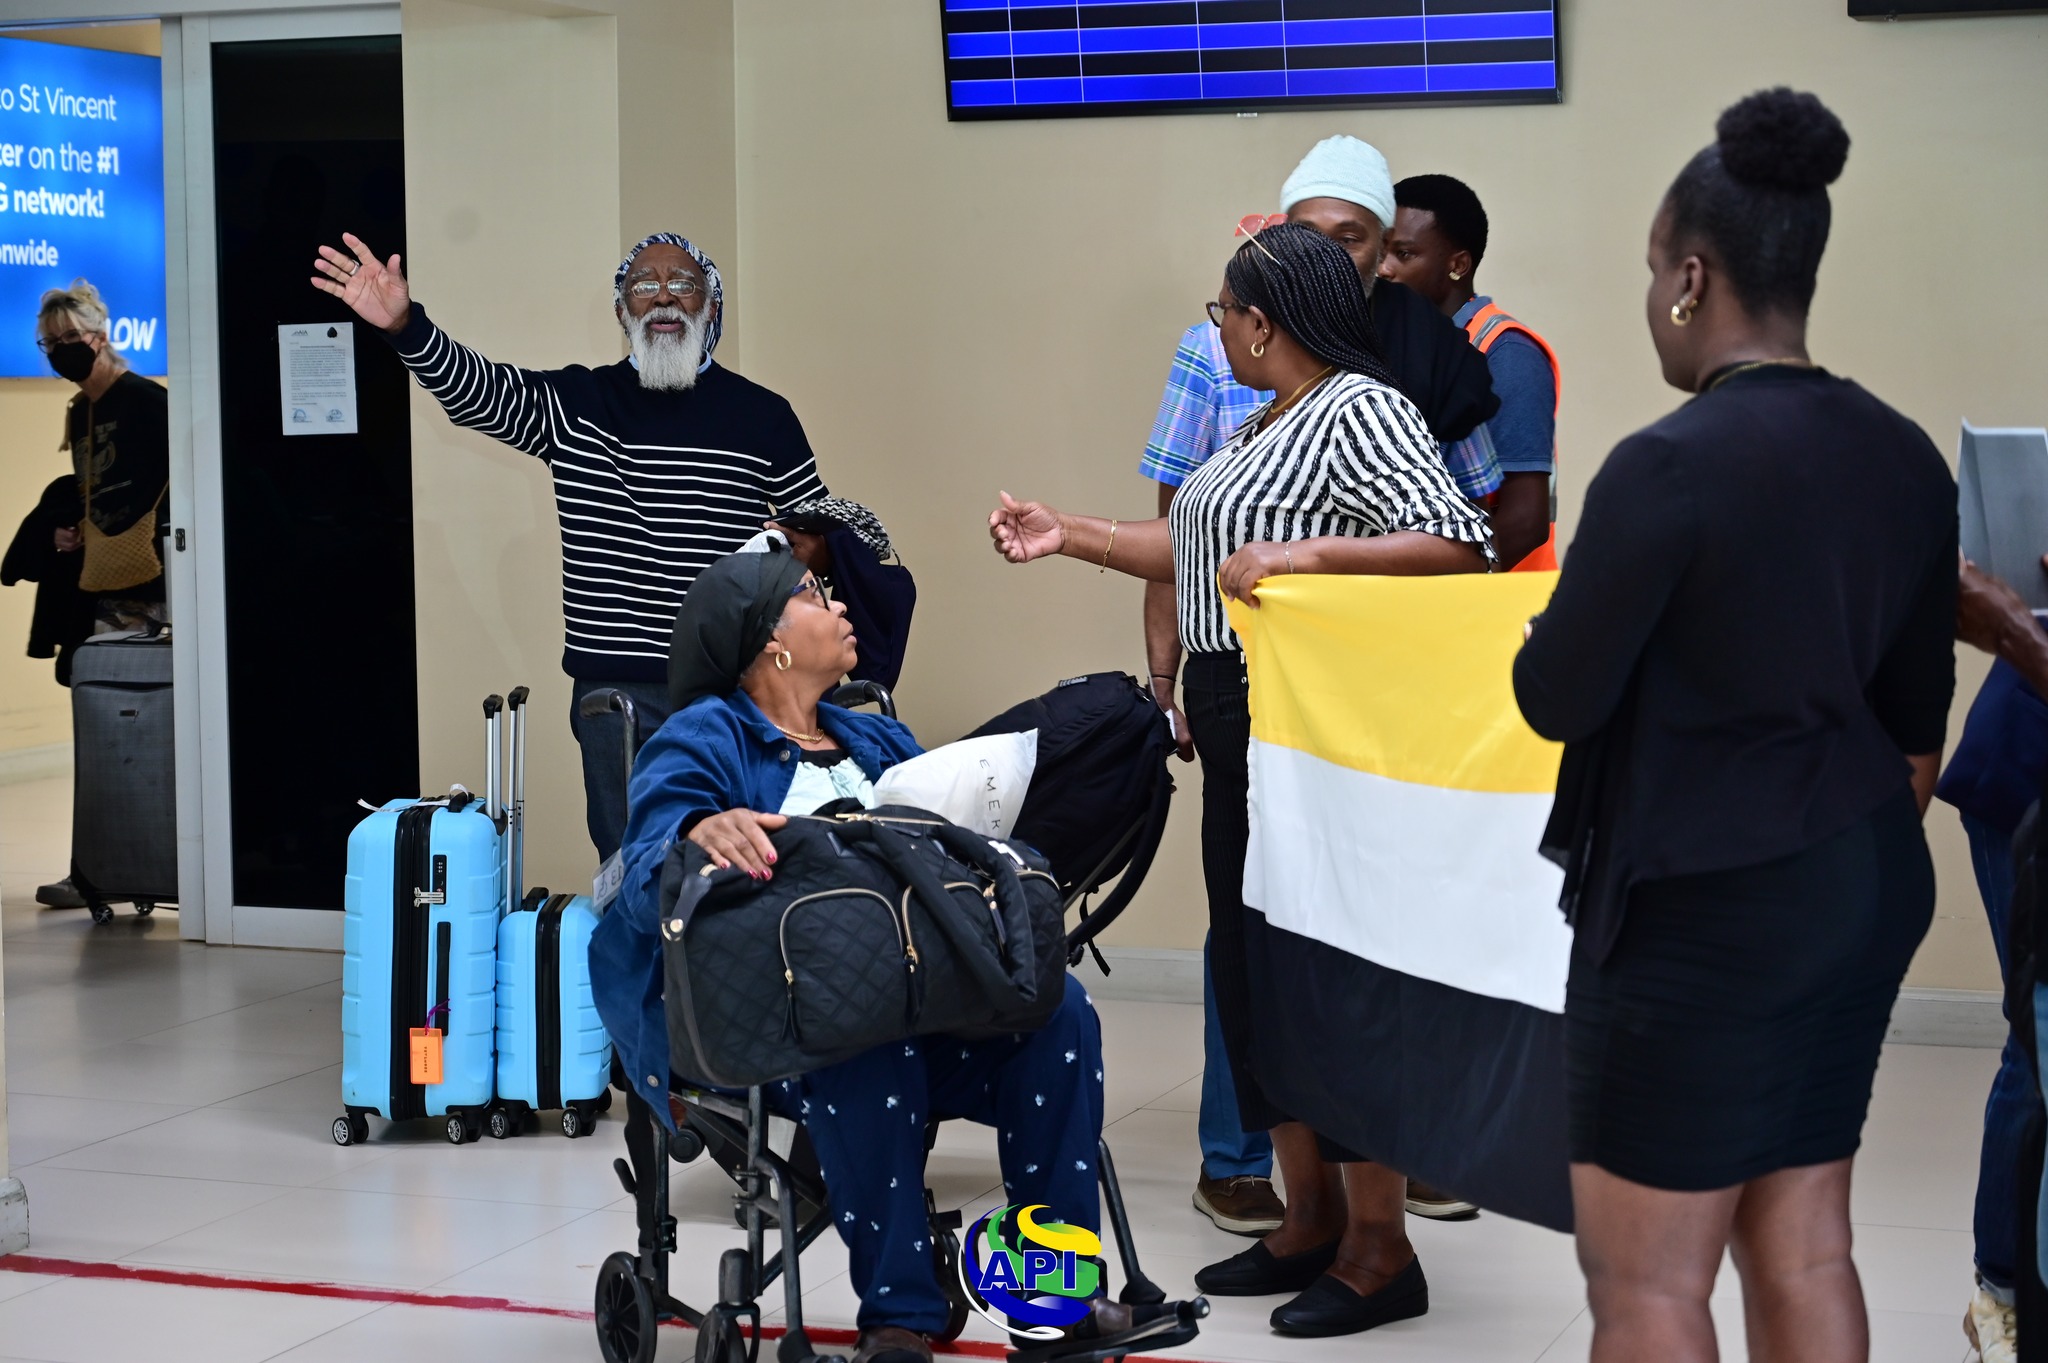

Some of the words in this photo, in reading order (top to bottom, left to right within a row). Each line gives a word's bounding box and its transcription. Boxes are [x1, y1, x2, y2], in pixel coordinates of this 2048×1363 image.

[19, 83, 41, 114] St
[44, 86, 118, 121] Vincent
[28, 146, 55, 171] on
[60, 142, 93, 173] the
[96, 146, 120, 175] #1
[14, 186, 105, 218] network!
[0, 239, 59, 267] nwide
